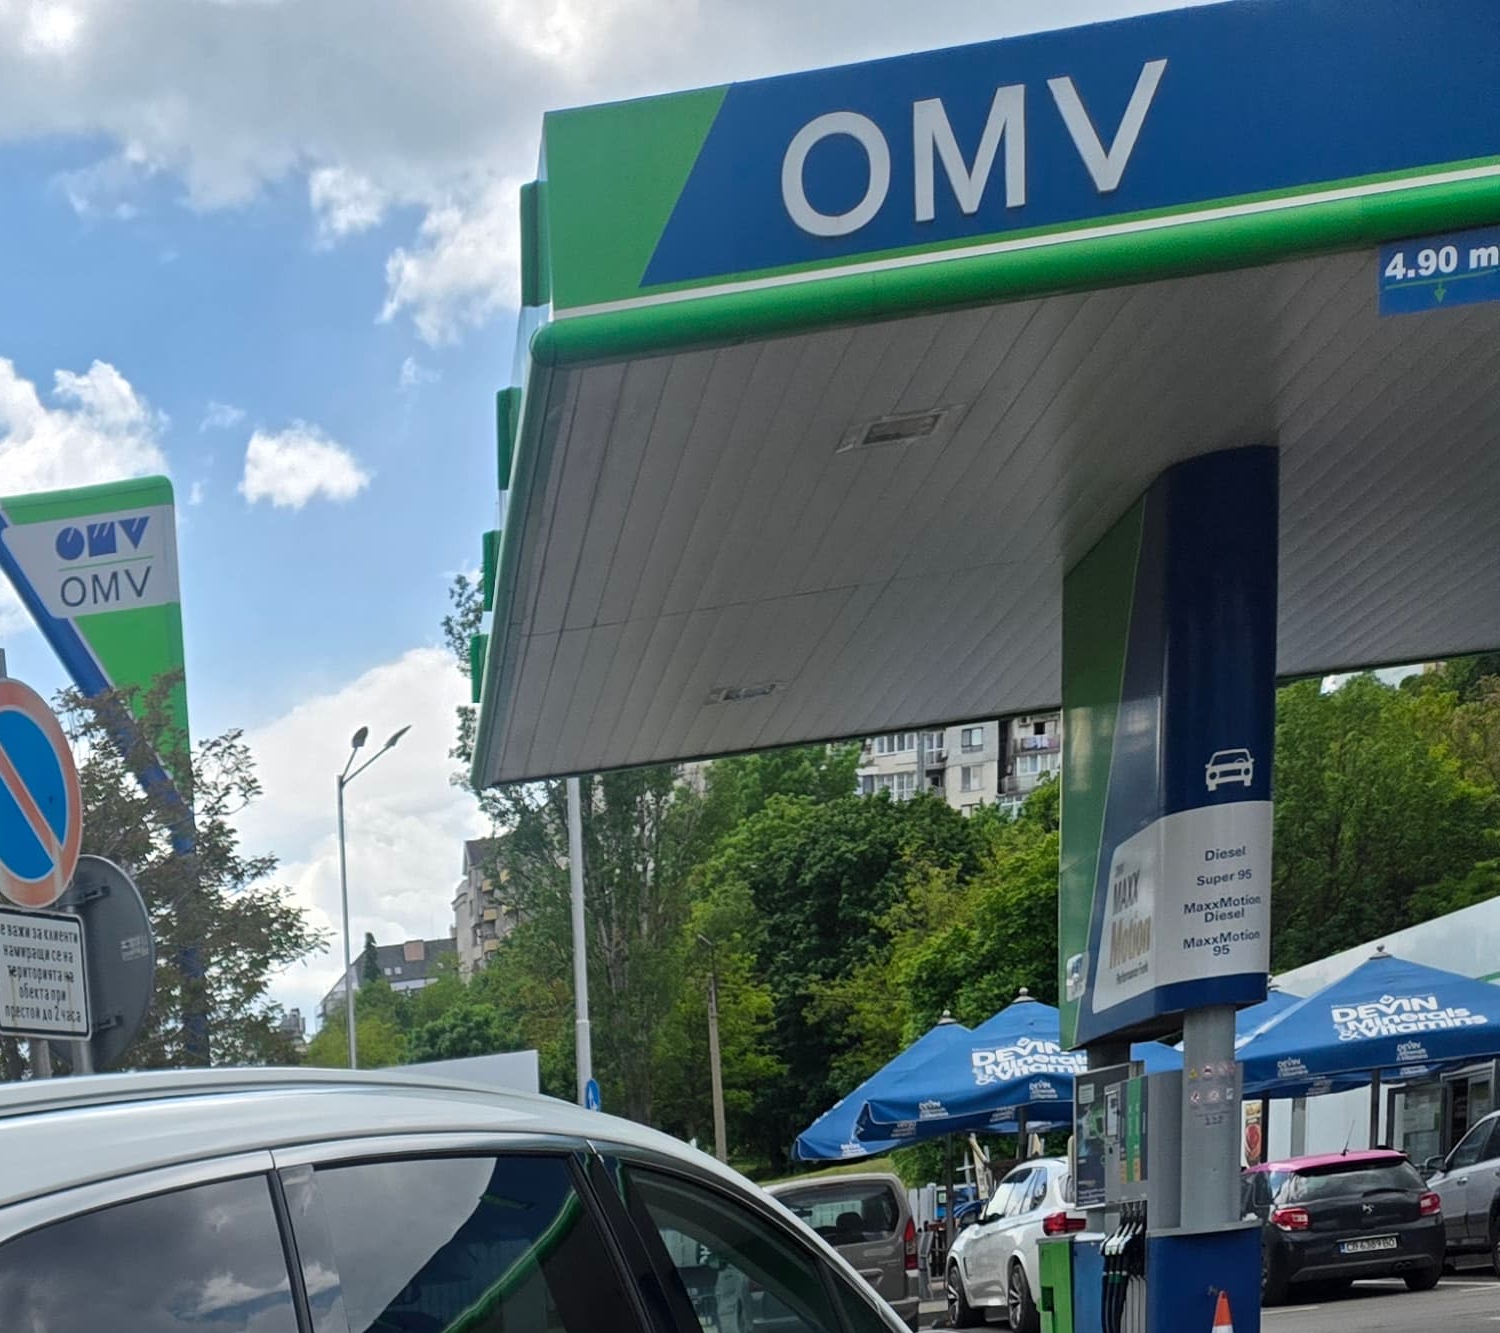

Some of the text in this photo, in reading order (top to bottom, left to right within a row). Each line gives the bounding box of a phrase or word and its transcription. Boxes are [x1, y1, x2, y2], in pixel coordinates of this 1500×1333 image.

[781, 58, 1169, 237] OMV
[1385, 245, 1499, 280] 4.90 m
[61, 566, 151, 607] OMV
[1205, 846, 1246, 862] Diesel
[1197, 869, 1252, 887] Super 95
[1184, 895, 1261, 915] MaxxMotion
[1204, 907, 1245, 923] Diesel
[7, 924, 30, 940] важи
[33, 927, 42, 941] за
[44, 929, 78, 944] клиенти
[1183, 929, 1260, 949] MaxxMotion
[3, 944, 74, 963] намиращи се на
[1213, 944, 1230, 956] 95
[7, 964, 74, 984] територията на
[19, 982, 66, 1005] обекта при
[5, 1005, 81, 1023] престой до 2 часа
[1331, 994, 1439, 1024] DEVIN
[1348, 1007, 1471, 1031] Minerals
[1358, 1014, 1488, 1038] Vitamins
